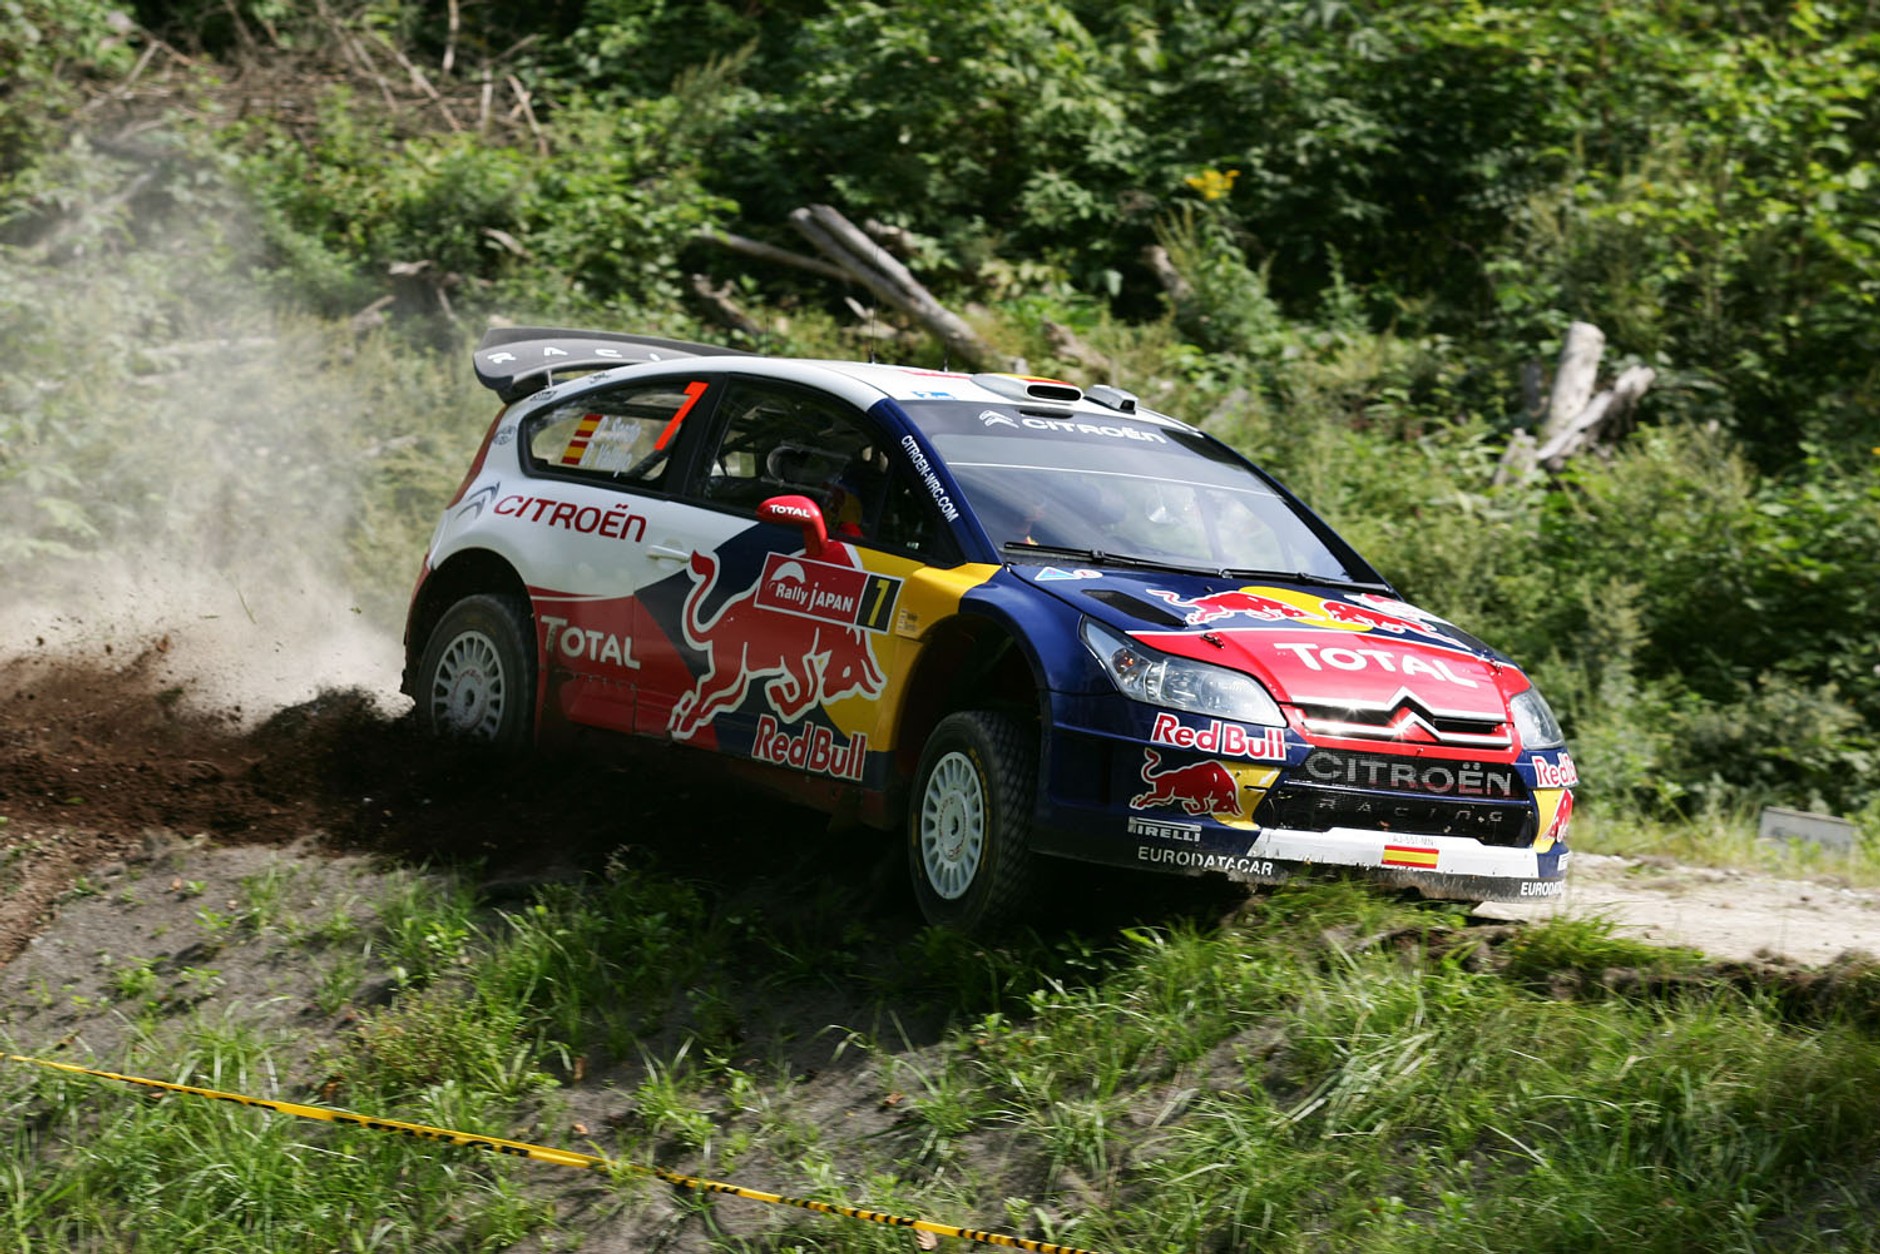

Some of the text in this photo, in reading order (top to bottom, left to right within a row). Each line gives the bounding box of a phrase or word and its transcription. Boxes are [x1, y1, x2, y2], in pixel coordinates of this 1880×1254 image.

[651, 381, 710, 450] 1
[900, 434, 960, 523] CITROEN-WRC.COM
[769, 504, 811, 519] TOTAL
[775, 583, 809, 606] Rally
[866, 578, 892, 628] 1
[539, 615, 642, 670] TOTAL
[1273, 641, 1480, 690] TOTAL
[751, 713, 868, 782] Red Bull
[1151, 712, 1288, 761] Red Bull
[1305, 751, 1512, 797] CITROËN
[1531, 753, 1573, 788] Red
[1127, 816, 1203, 843] PIRELLI
[1137, 846, 1275, 877] EURODATACAR
